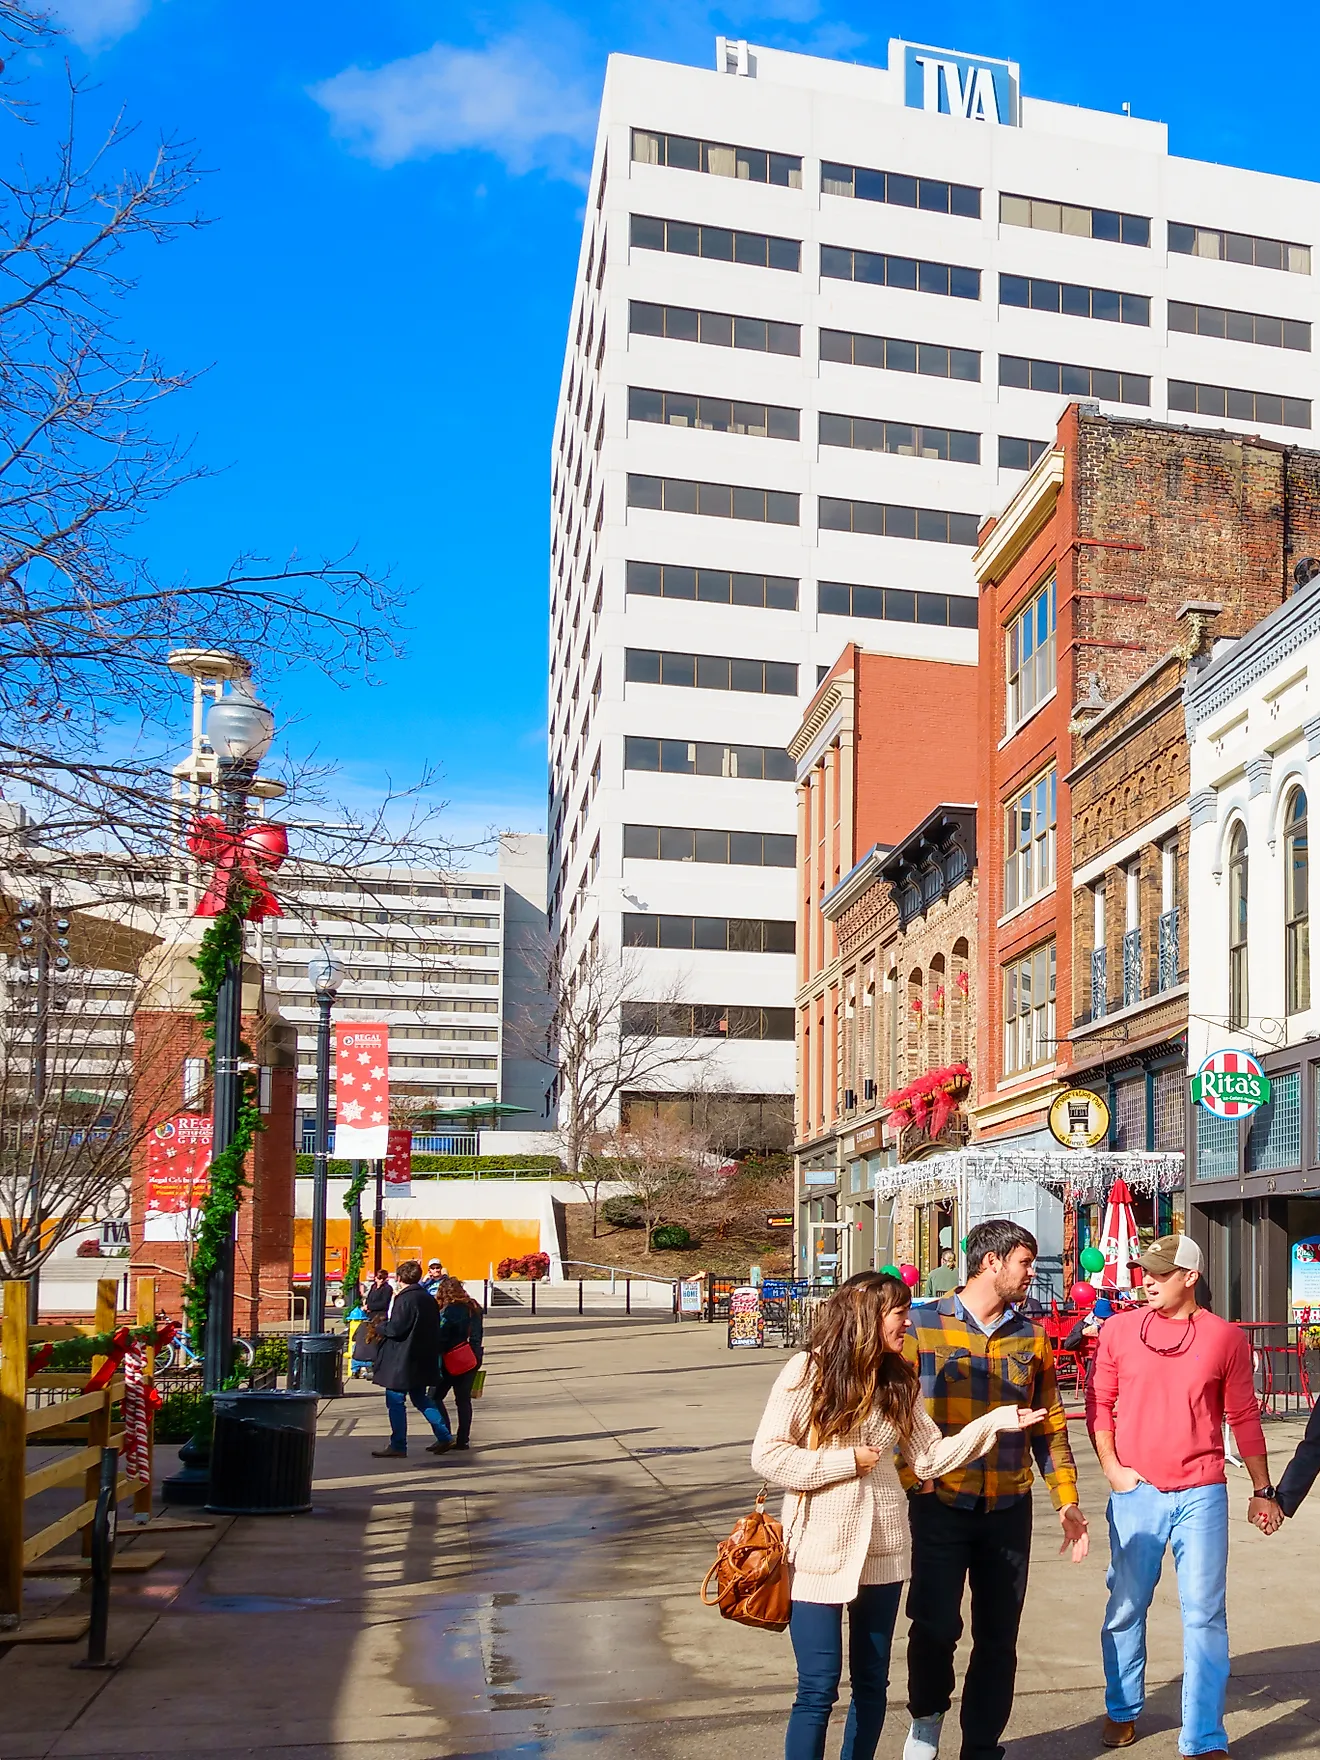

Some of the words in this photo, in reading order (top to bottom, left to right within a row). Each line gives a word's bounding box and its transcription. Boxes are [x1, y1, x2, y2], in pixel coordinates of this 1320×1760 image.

[915, 55, 1001, 124] TVA
[1200, 1070, 1261, 1098] Rita's
[178, 1117, 214, 1129] REG
[101, 1221, 131, 1243] TVA
